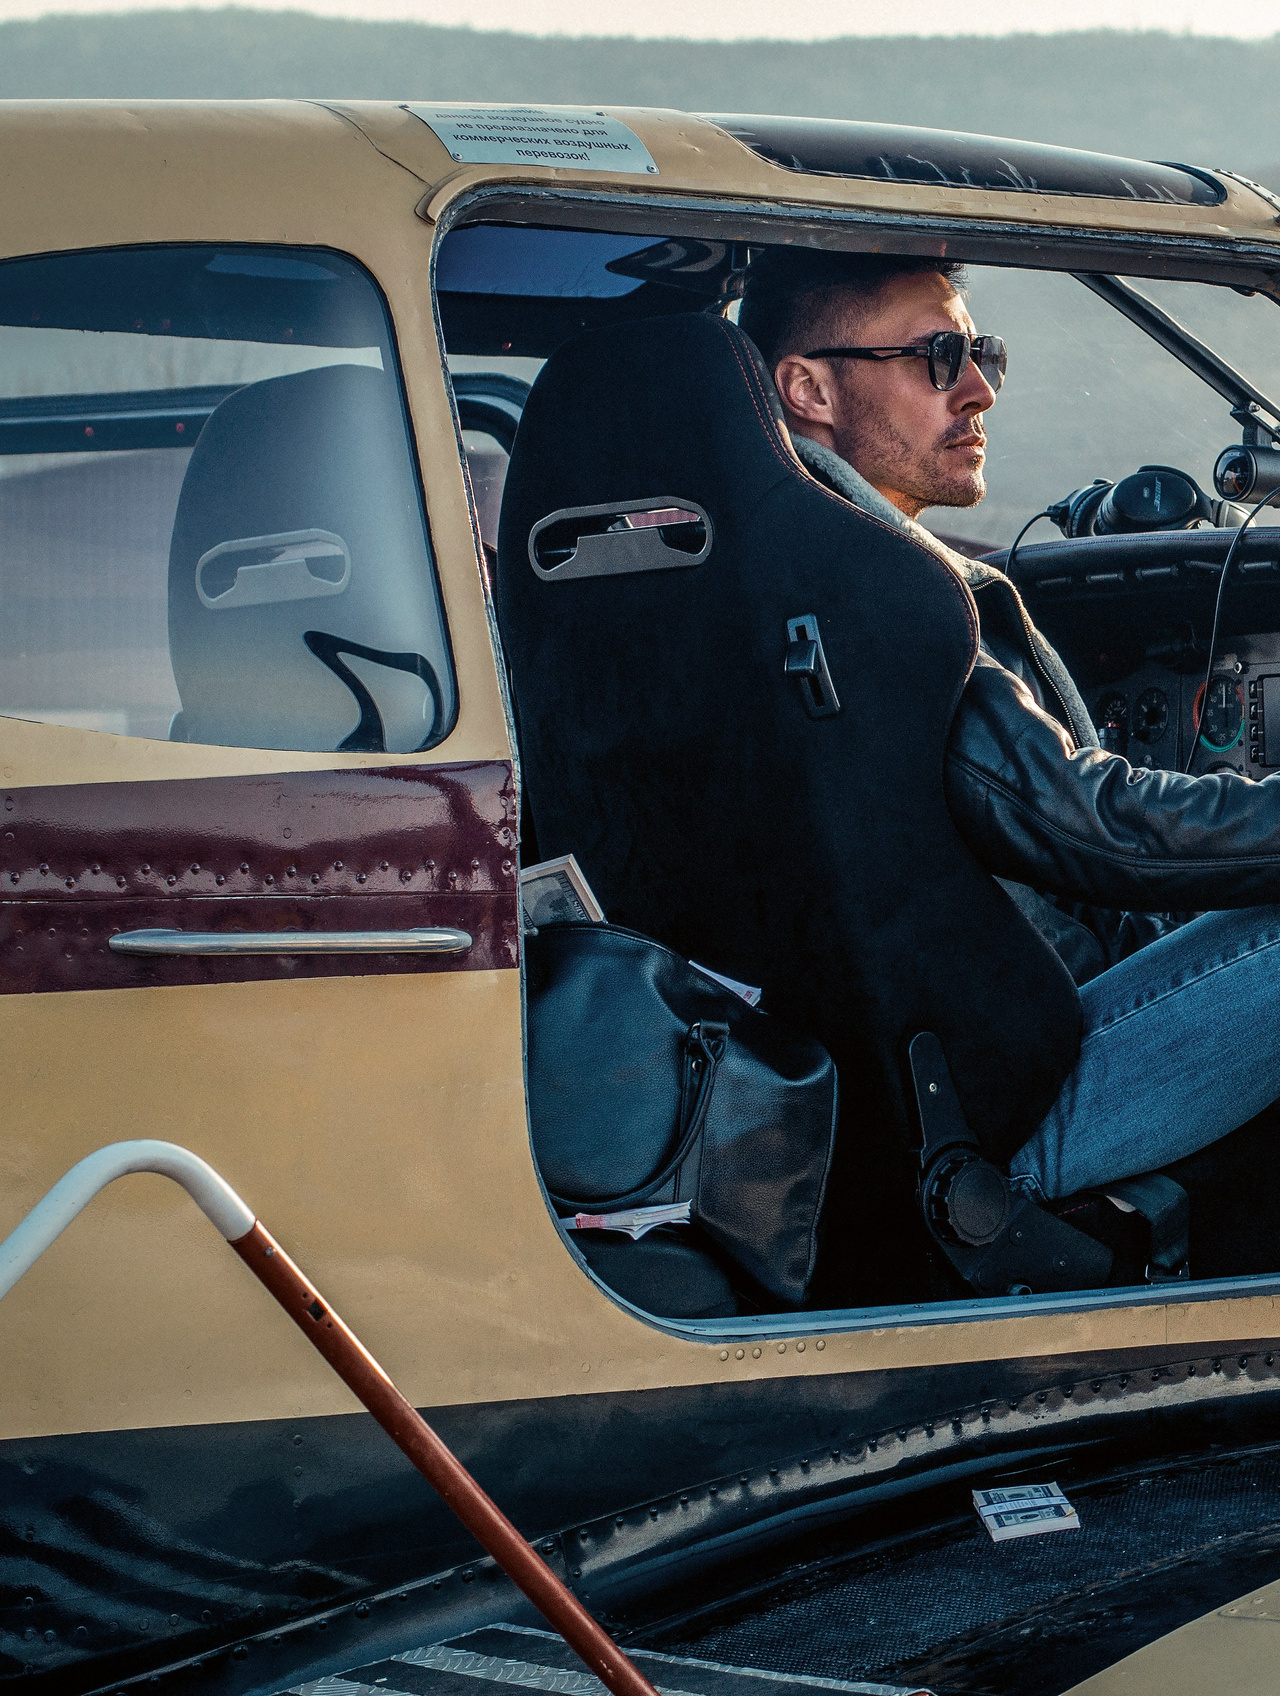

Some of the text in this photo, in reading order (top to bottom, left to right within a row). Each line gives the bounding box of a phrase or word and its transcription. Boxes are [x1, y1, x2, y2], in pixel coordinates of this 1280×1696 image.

[486, 115, 563, 123] воздушное
[565, 118, 605, 126] судно
[475, 123, 580, 135] предназначено
[452, 133, 632, 151] коммерческих воздушных
[515, 149, 591, 161] перевозок!
